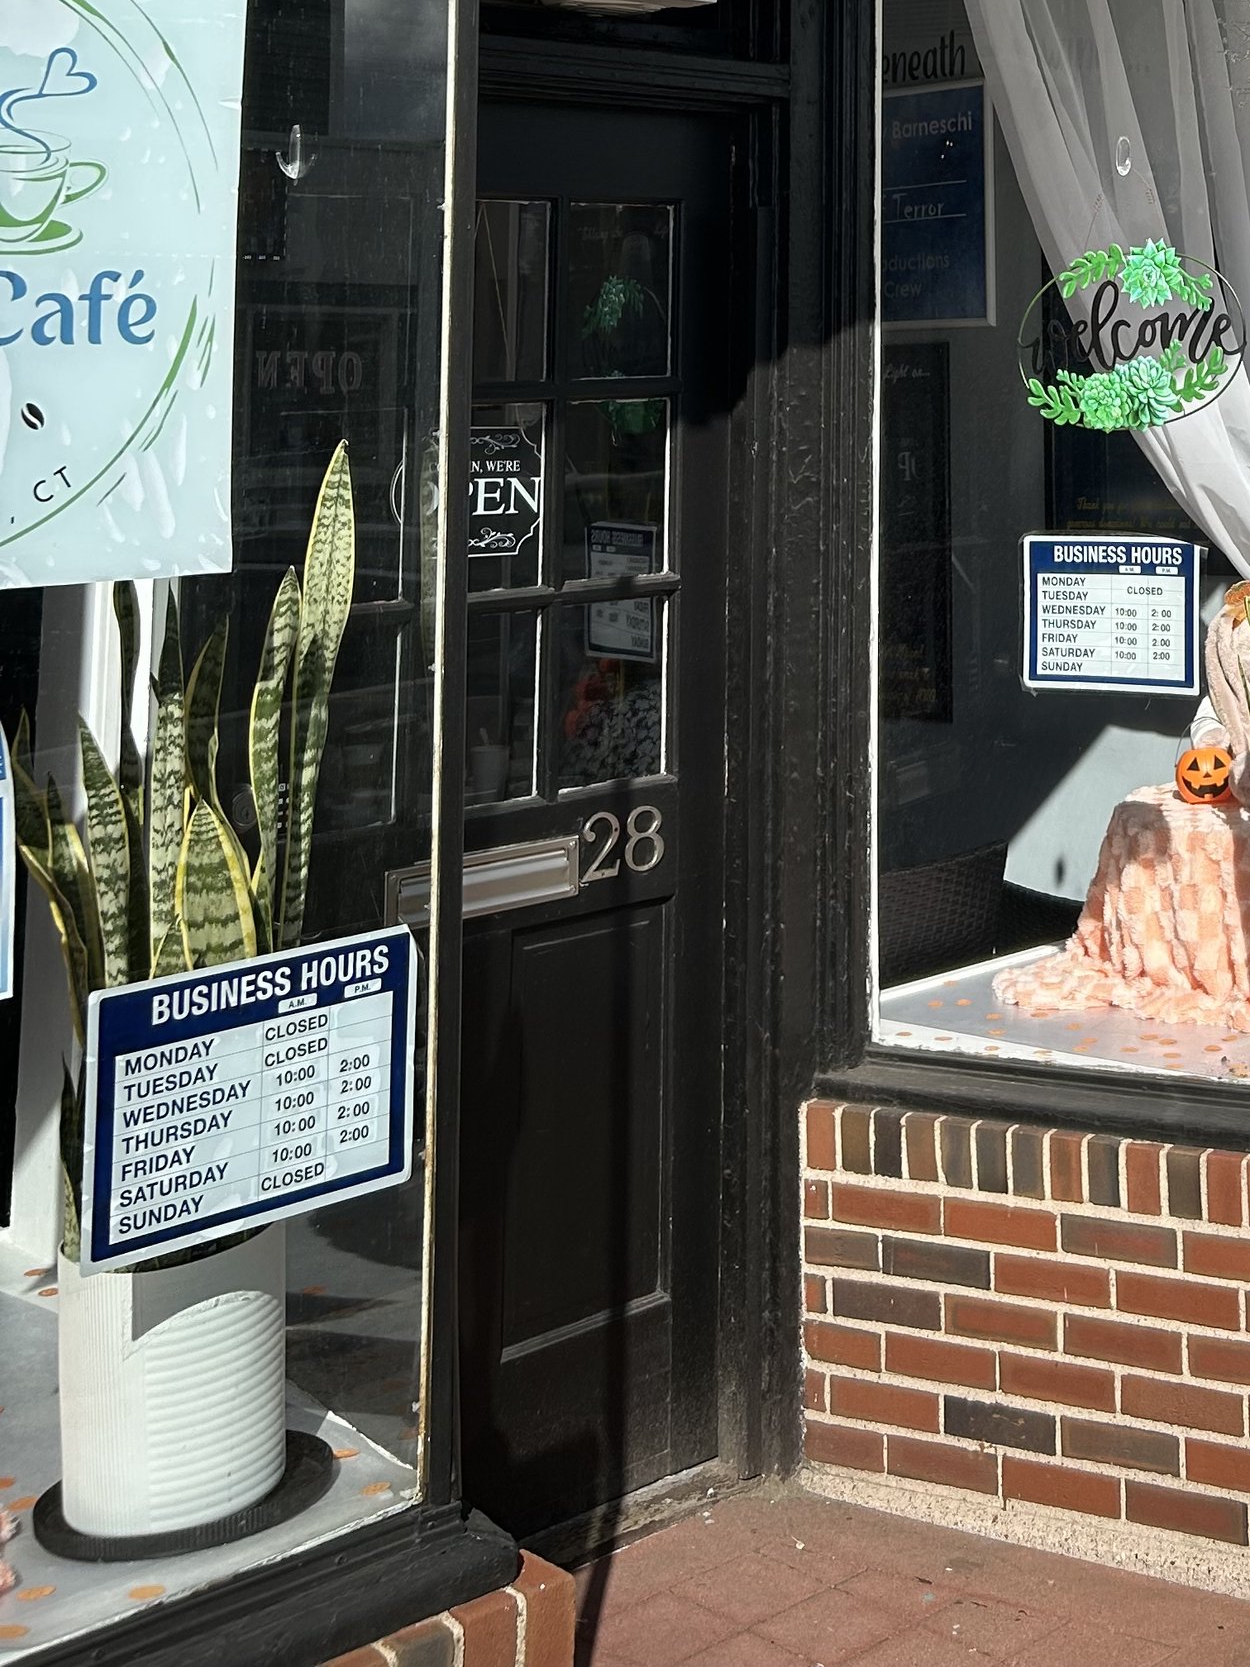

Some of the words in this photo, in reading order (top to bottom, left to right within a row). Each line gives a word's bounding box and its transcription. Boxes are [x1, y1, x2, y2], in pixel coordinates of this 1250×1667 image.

[892, 192, 946, 218] Terror
[33, 466, 71, 502] CT
[1053, 544, 1127, 564] BUSINESS
[1130, 546, 1183, 566] HOURS
[1042, 576, 1086, 587] MONDAY
[1126, 586, 1163, 597] CLOSED
[1042, 590, 1089, 601] TUESDAY
[1042, 605, 1106, 616] WEDNESDAY
[1115, 608, 1138, 618] 10:00
[1042, 619, 1097, 630] THURSDAY
[1115, 622, 1138, 632] 10:00
[1041, 633, 1078, 644] FRIDAY
[1114, 636, 1138, 646] 10:00
[1041, 647, 1096, 658] SATURDAY
[1114, 651, 1137, 661] 10:00
[1041, 661, 1083, 672] SUNDAY
[580, 805, 665, 883] 28
[151, 965, 291, 1026] BUSINESS
[300, 944, 390, 992] HOURS
[288, 997, 308, 1009] A.M.
[353, 983, 371, 994] P.M.
[124, 1038, 215, 1077] MONDAY
[265, 1013, 329, 1041] CLOSED
[123, 1063, 219, 1102] TUESDAY
[264, 1037, 328, 1068] CLOSED
[123, 1080, 251, 1129] WEDNESDAY
[276, 1064, 316, 1087] 10:00
[339, 1054, 370, 1073] 2:00
[121, 1110, 233, 1155] THURSDAY
[274, 1091, 315, 1112] 10:00
[340, 1075, 372, 1095] 2:00
[120, 1145, 196, 1182] FRIDAY
[273, 1115, 316, 1135] 10:00
[337, 1101, 370, 1120] 2:00
[119, 1162, 229, 1208] SATURDAY
[272, 1142, 313, 1163] 10:00
[339, 1125, 369, 1144] 2:00
[118, 1195, 204, 1235] SUNDAY
[261, 1162, 325, 1192] CLOSED
